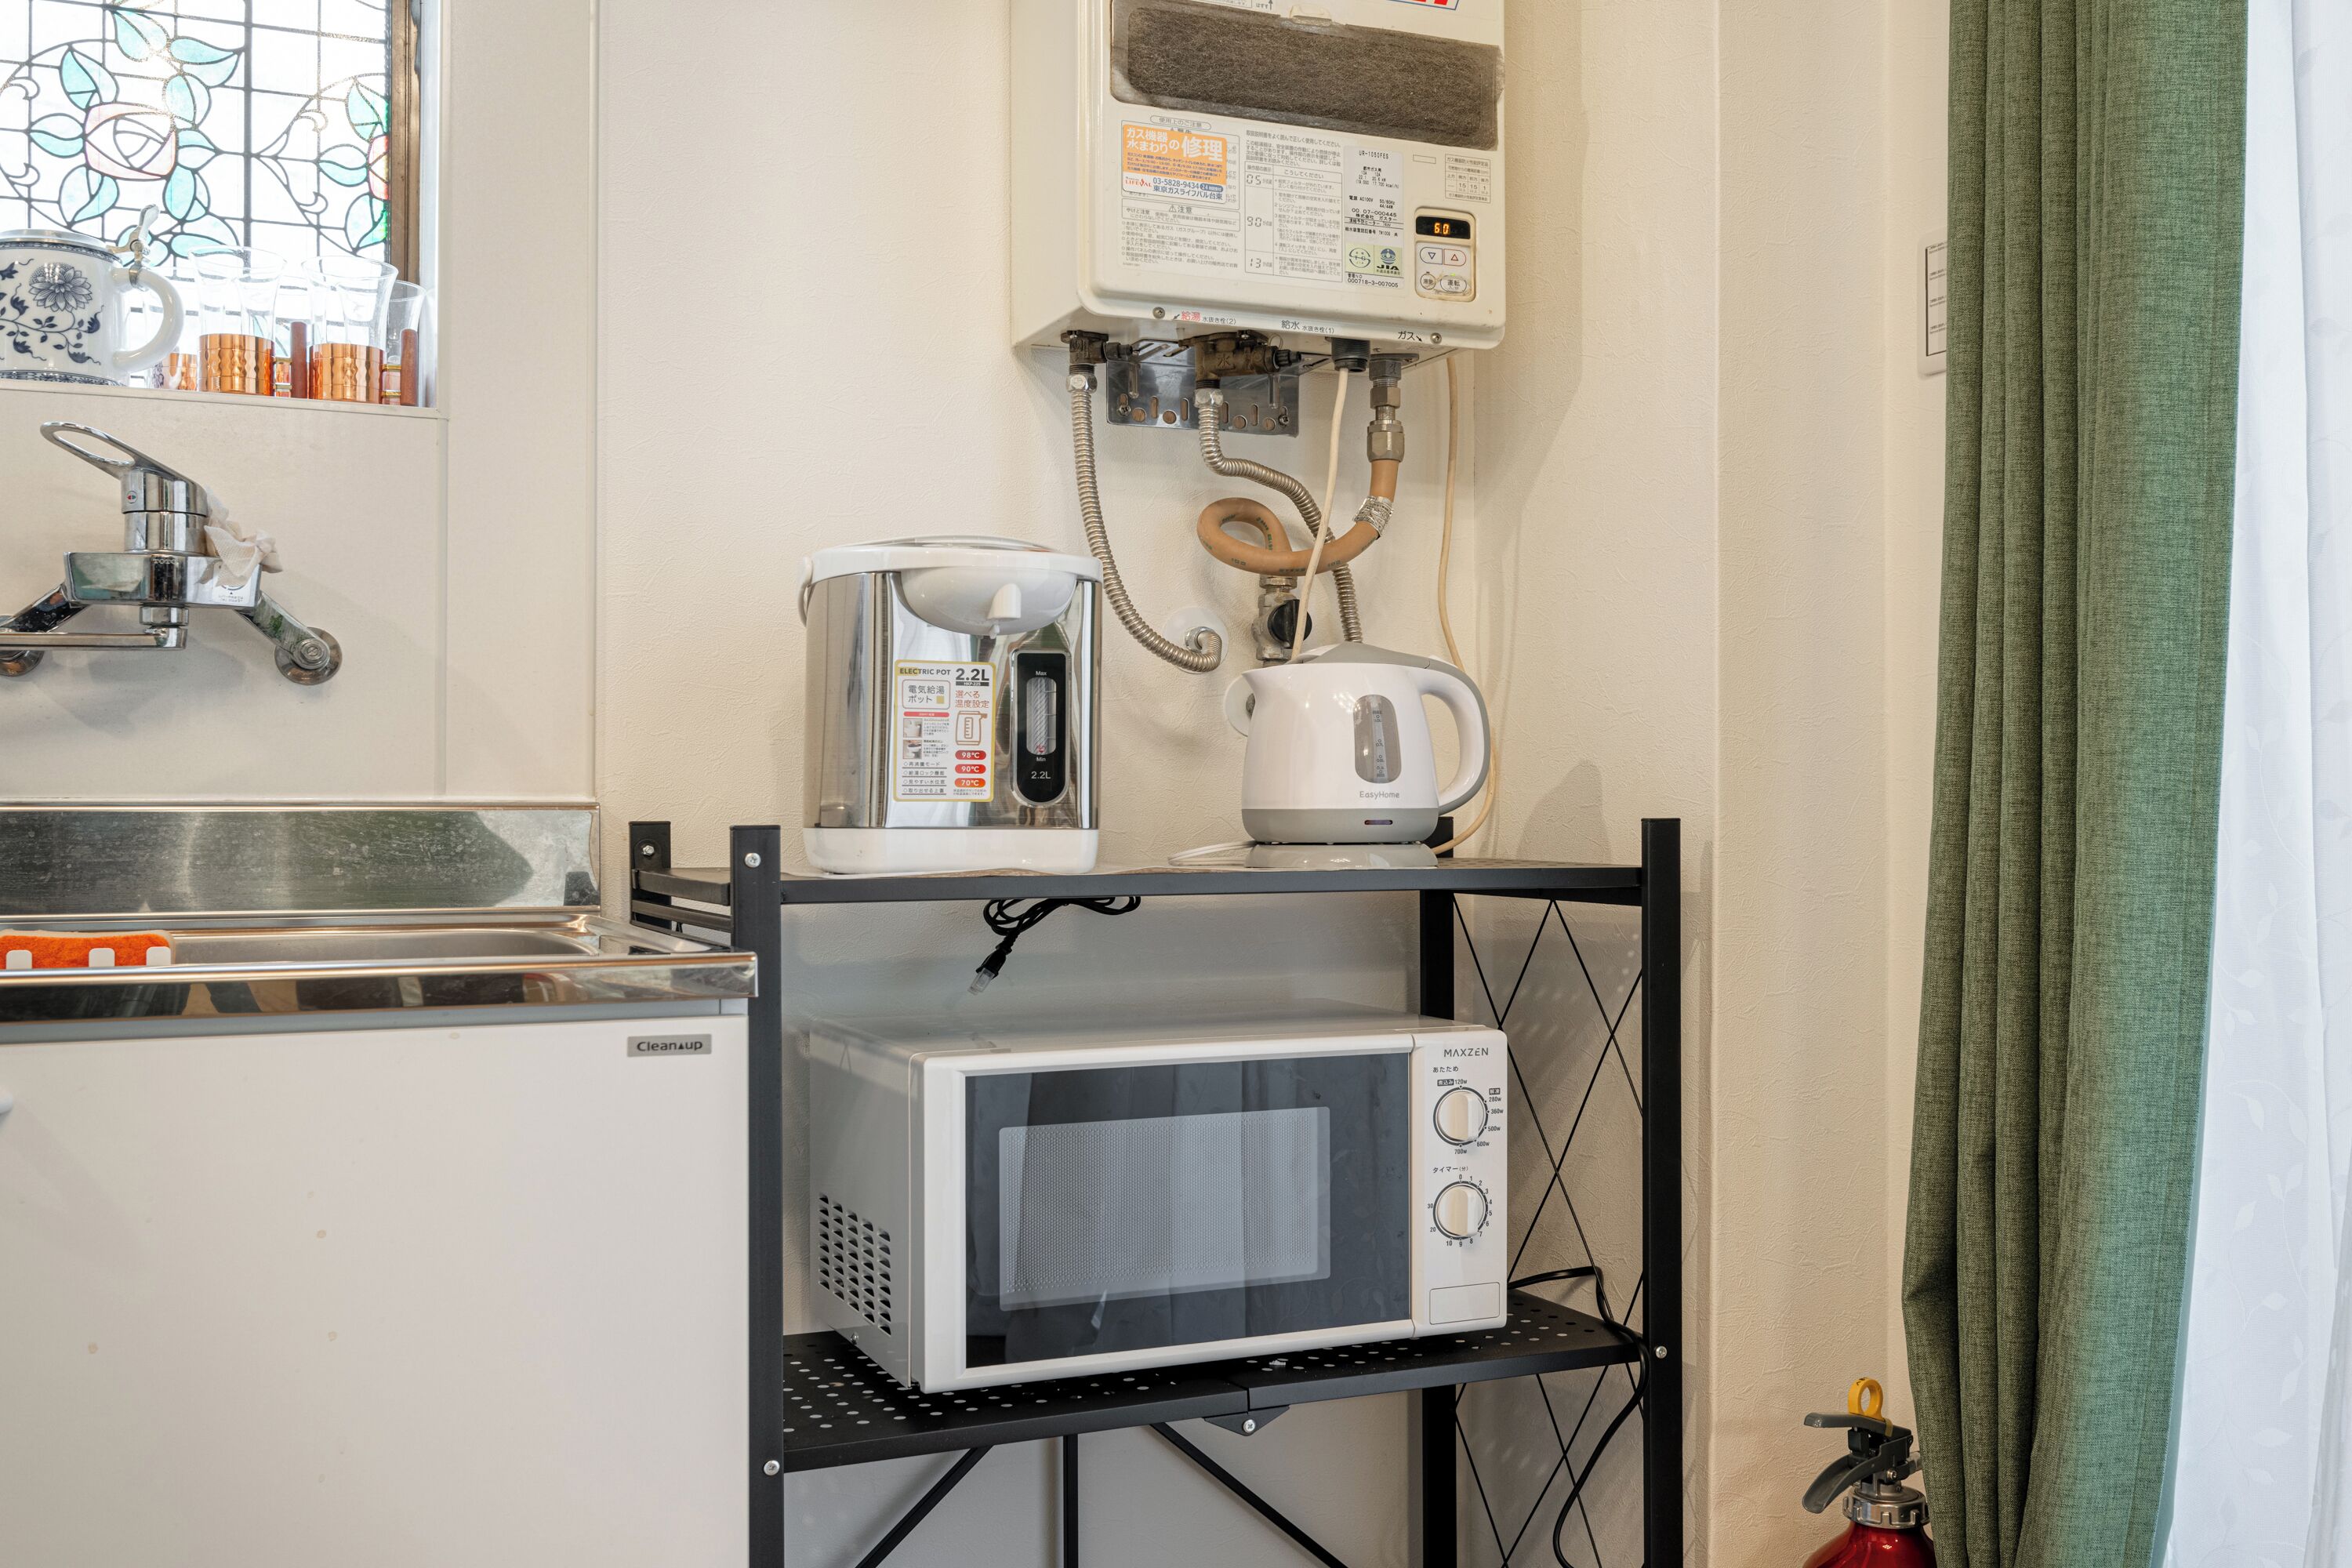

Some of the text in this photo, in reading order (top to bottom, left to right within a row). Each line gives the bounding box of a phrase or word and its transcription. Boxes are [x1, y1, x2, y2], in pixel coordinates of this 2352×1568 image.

[1127, 127, 1168, 143] ガス機器
[1127, 140, 1168, 154] 水まわり
[1152, 176, 1200, 190] 03-5828-9434
[1152, 184, 1223, 201] 東京ガスライフバル台東
[1177, 205, 1192, 214] 注意
[1247, 216, 1261, 227] 90
[1434, 223, 1450, 234] 60
[1181, 310, 1201, 321] 給湯
[1281, 319, 1301, 330] 給水
[1398, 330, 1416, 341] ガス
[955, 667, 990, 681] 2.2L
[908, 684, 945, 695] 電気給湯
[955, 690, 980, 699] 選べる
[955, 699, 989, 709] 温度設定
[1031, 771, 1051, 780] 2.2L
[1359, 790, 1400, 800] EasyHome
[1443, 1047, 1489, 1058] MAXZEN
